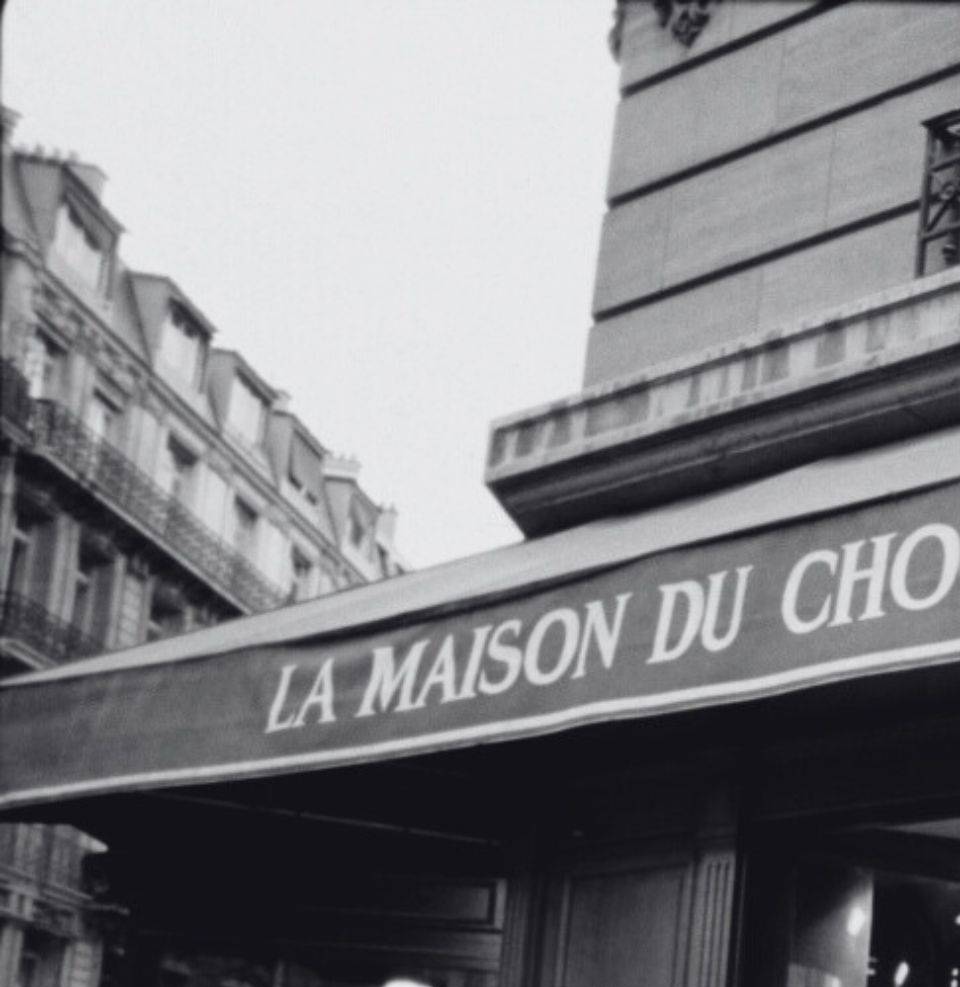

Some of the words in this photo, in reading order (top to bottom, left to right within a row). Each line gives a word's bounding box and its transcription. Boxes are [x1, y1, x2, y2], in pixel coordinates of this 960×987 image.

[265, 658, 335, 734] LA
[355, 591, 633, 718] MAISON
[646, 564, 753, 665] DU
